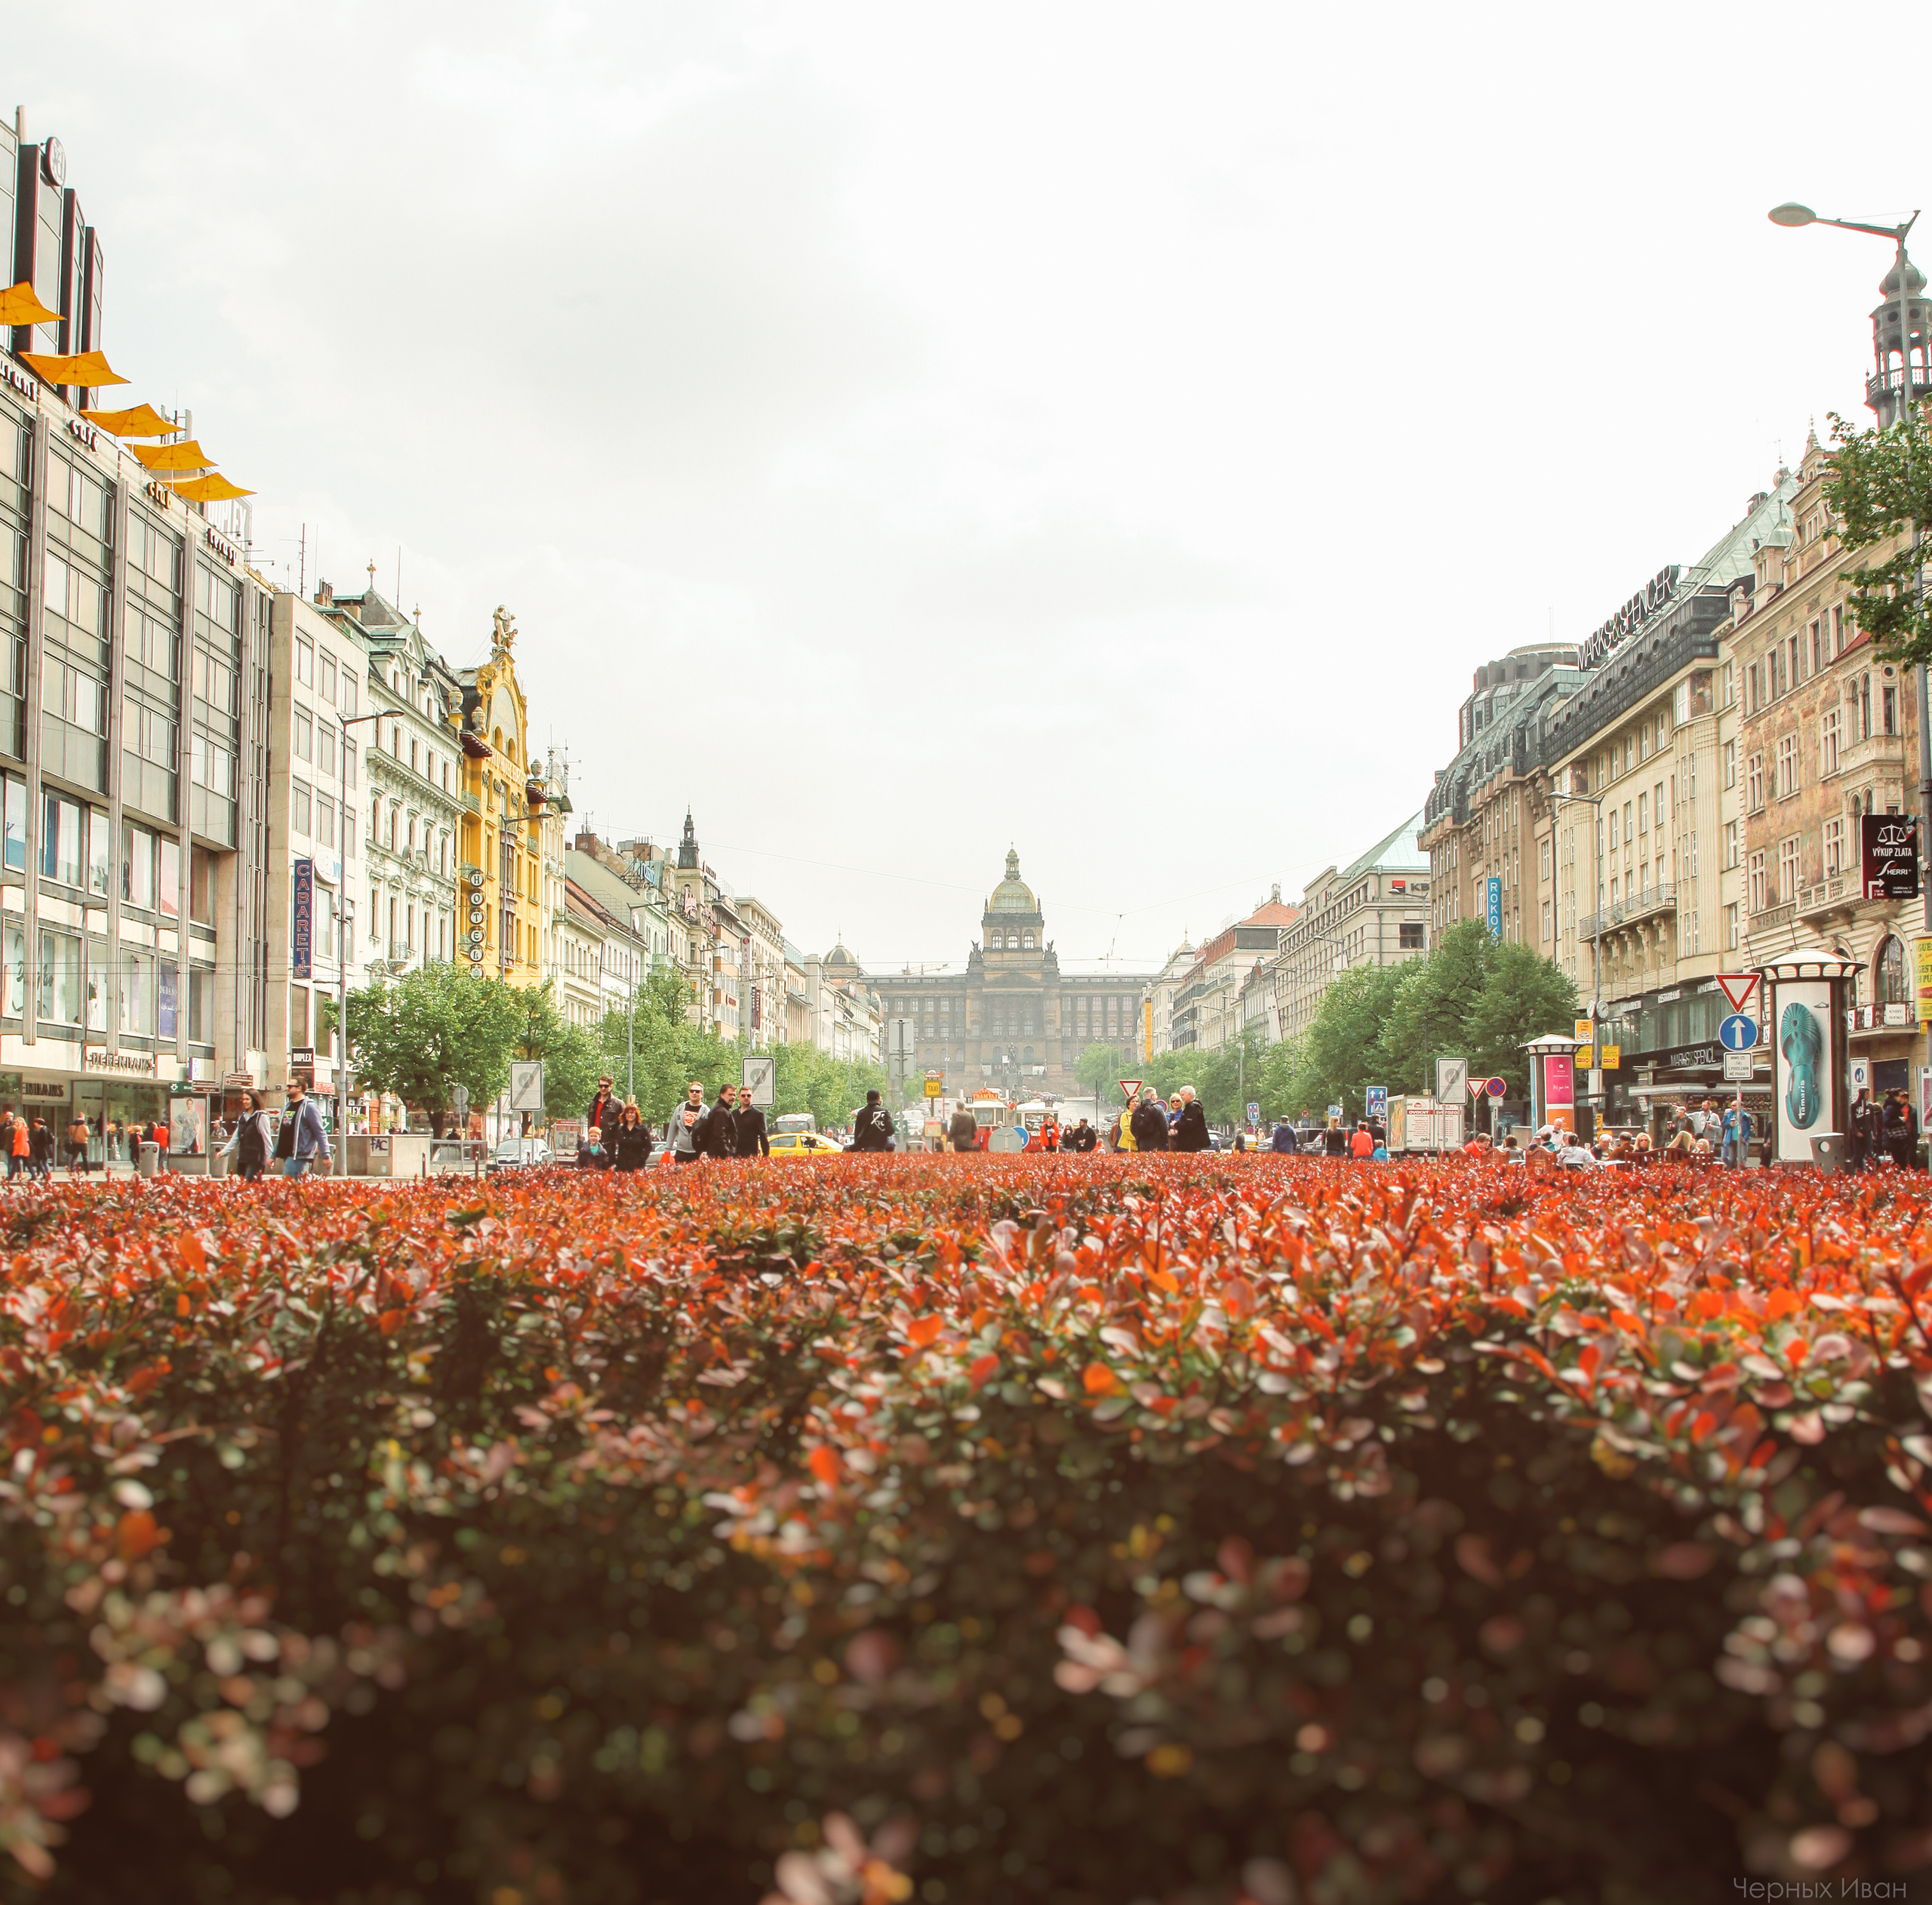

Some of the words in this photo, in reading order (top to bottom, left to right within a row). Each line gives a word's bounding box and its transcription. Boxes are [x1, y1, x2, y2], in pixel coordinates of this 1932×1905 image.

[147, 481, 172, 509] club
[206, 528, 238, 566] terasy
[1872, 846, 1893, 857] VÝKUP
[1894, 848, 1912, 857] ZLATA
[1411, 882, 1429, 891] KB
[297, 864, 310, 961] CABARET
[293, 1053, 312, 1063] DUPLEX
